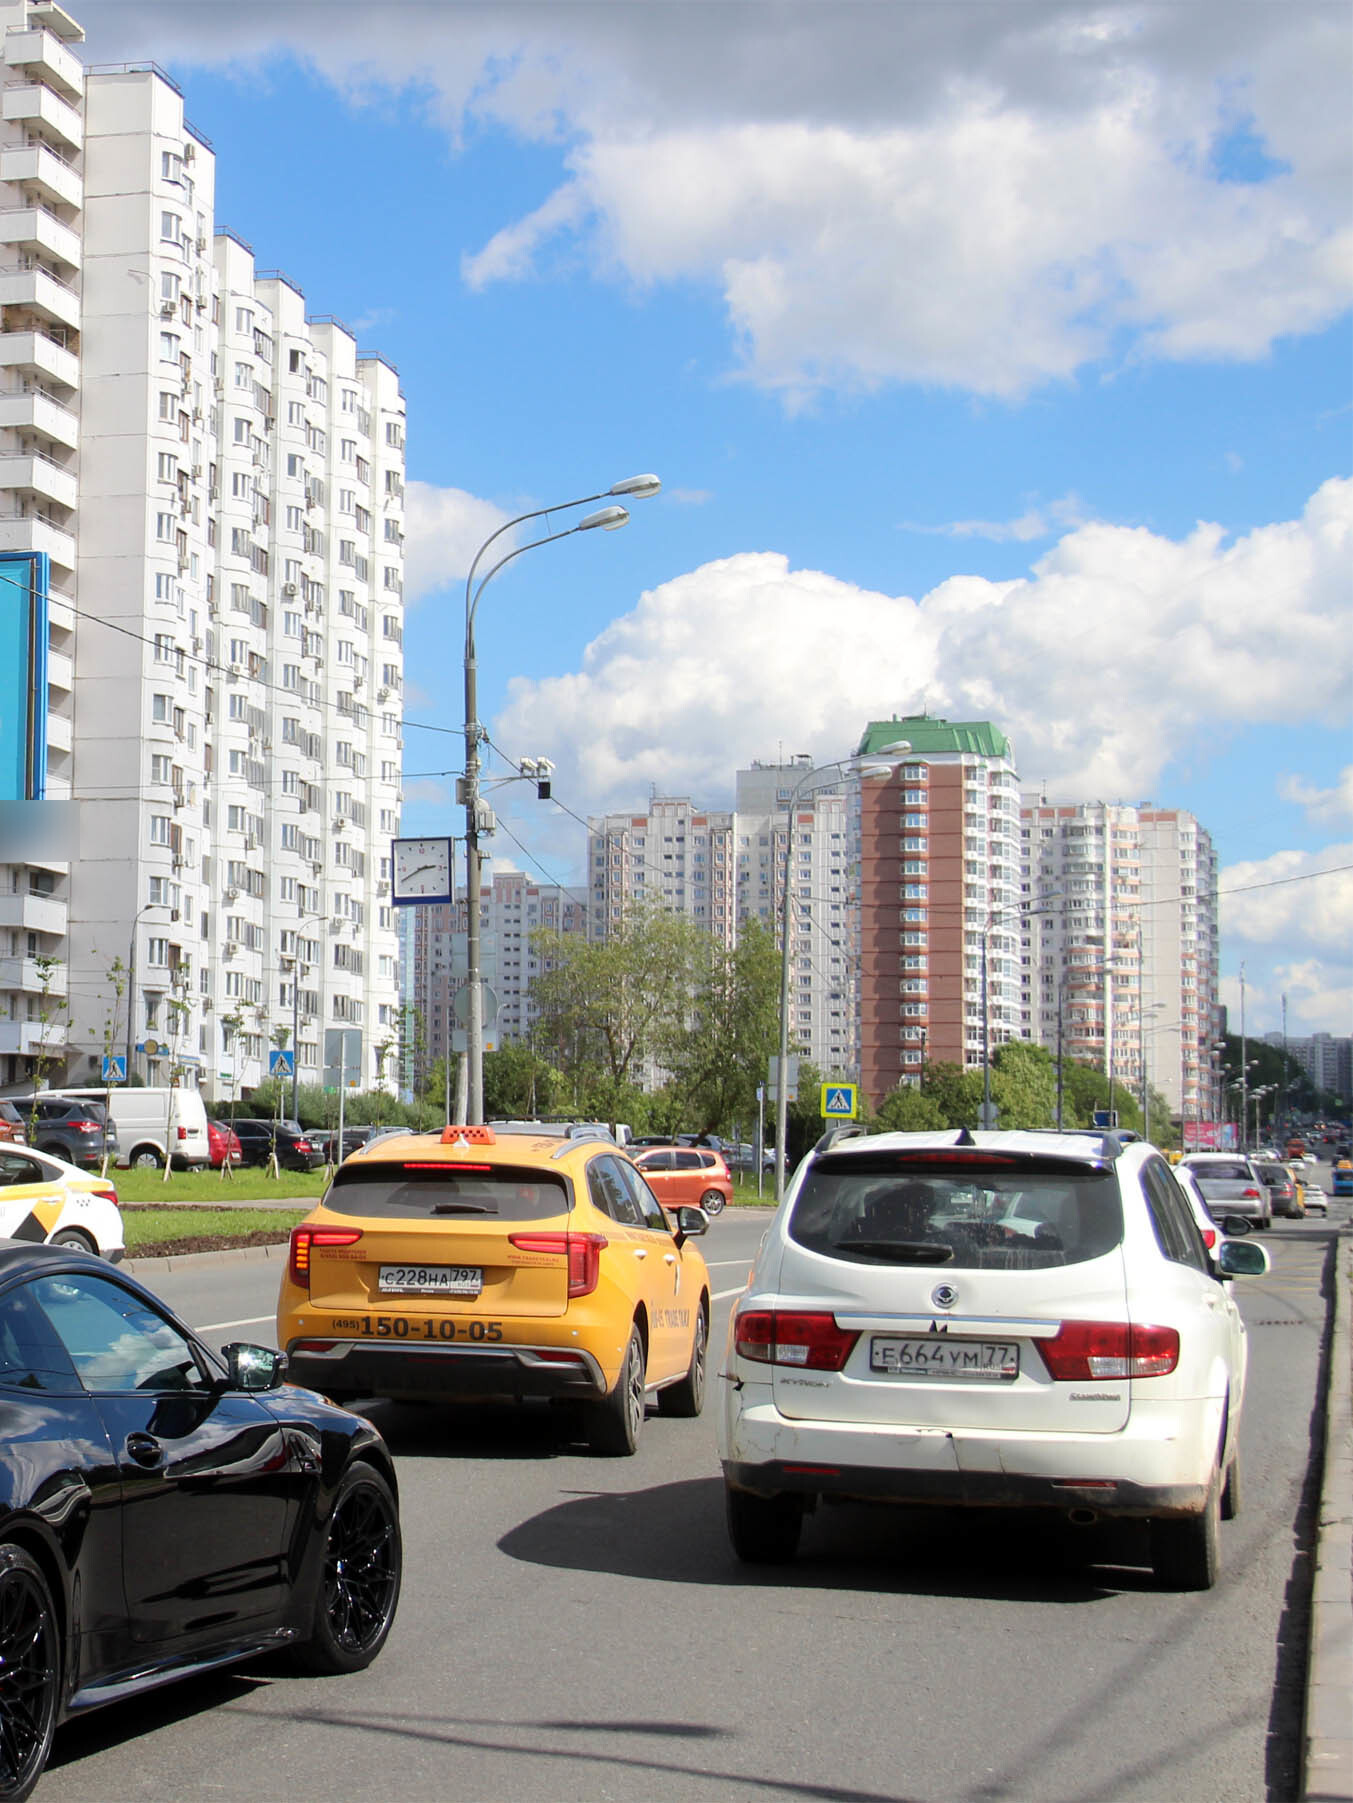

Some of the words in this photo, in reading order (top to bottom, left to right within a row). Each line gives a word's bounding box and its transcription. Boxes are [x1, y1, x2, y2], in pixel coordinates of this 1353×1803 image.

[385, 1269, 449, 1287] С228НА
[452, 1269, 477, 1283] 797
[332, 1319, 360, 1331] (495)
[361, 1316, 503, 1341] 150-10-05
[882, 1343, 979, 1367] Е664УМ
[985, 1345, 1009, 1364] 77
